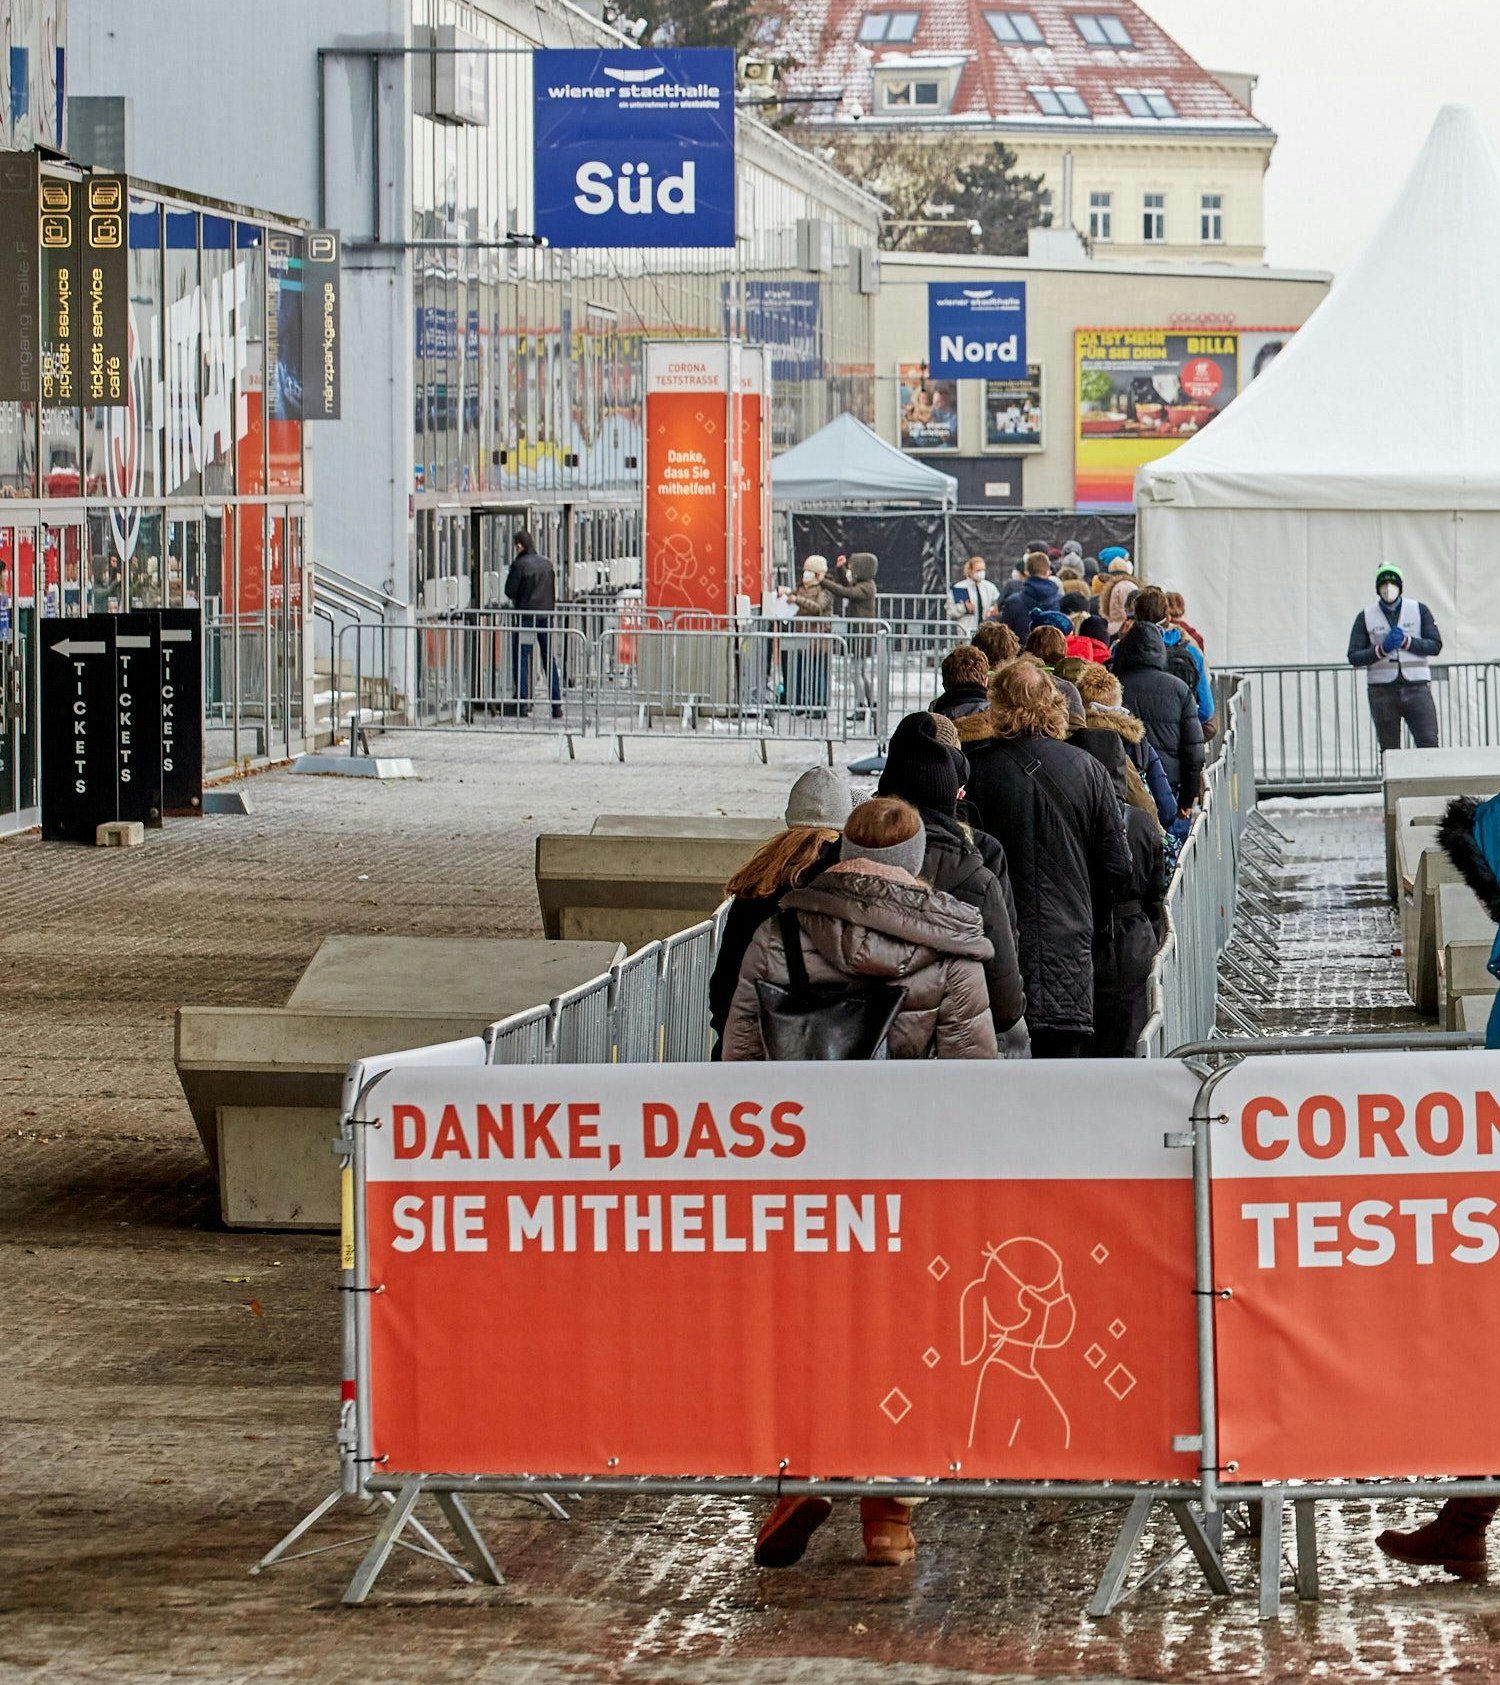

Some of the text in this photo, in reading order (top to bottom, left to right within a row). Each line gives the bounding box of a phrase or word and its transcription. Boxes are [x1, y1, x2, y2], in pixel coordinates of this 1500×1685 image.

[548, 84, 720, 98] wiener stadthalle
[574, 161, 695, 215] Süd
[16, 240, 33, 393] eingang halle F
[90, 268, 104, 399] ticket service
[323, 282, 336, 413] märzparkgarage
[668, 363, 706, 373] CORONA
[940, 334, 1018, 363] Nord
[1187, 337, 1235, 354] BILLA
[106, 356, 120, 399] café
[656, 375, 719, 385] TESTSTRASSE
[663, 465, 711, 479] dass Sie
[667, 449, 706, 465] Danke,
[657, 481, 716, 495] mithelfen!
[73, 662, 87, 793] TICKETS
[119, 655, 132, 782] TICKETS
[162, 649, 174, 771] TICKETS
[391, 1100, 808, 1172] DANKE, DASS
[391, 1193, 903, 1253] SIE MITHELFEN!
